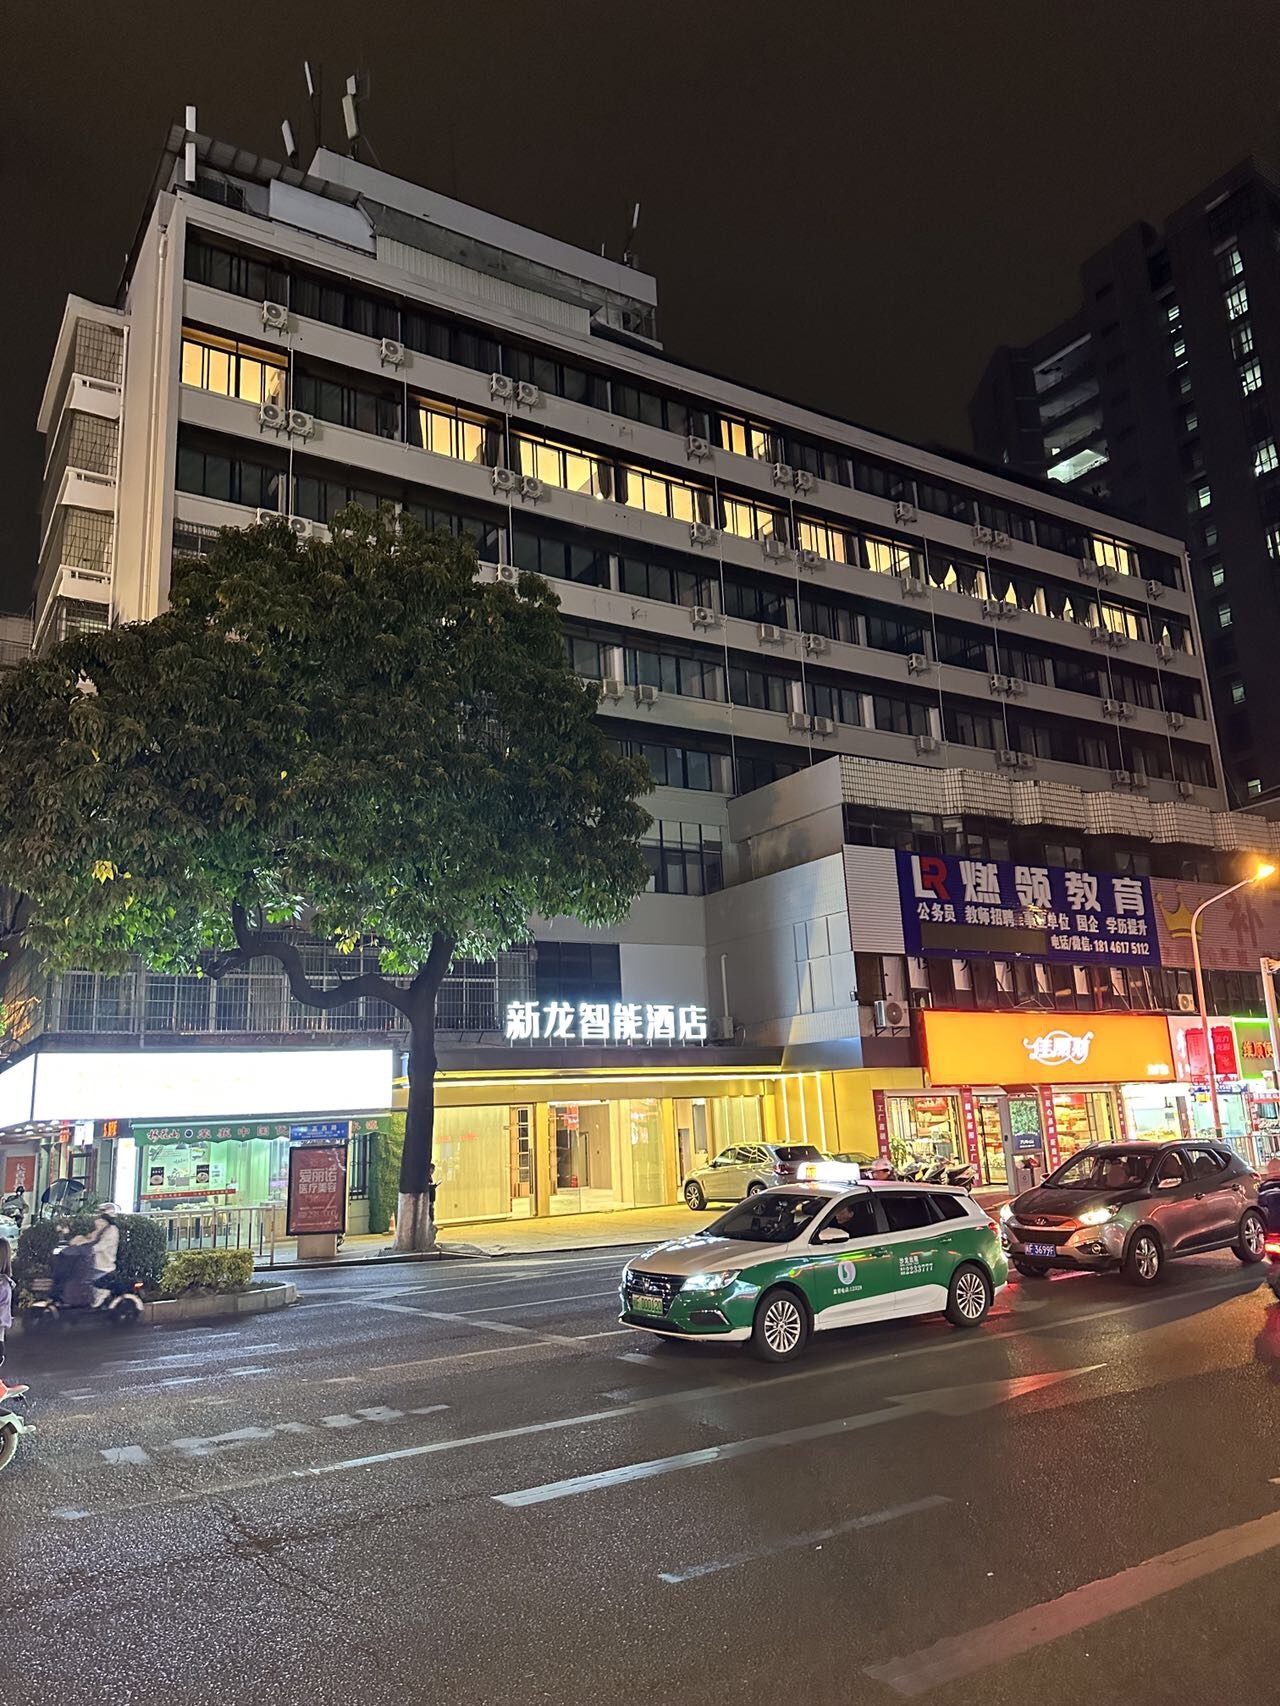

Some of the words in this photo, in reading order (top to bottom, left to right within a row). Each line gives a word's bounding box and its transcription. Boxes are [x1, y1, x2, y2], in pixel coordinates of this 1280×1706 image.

[959, 860, 1145, 916] 燃领教育
[917, 902, 956, 922] 公务员
[965, 905, 1015, 927] 教师招聘
[1076, 914, 1099, 933] 国企
[1106, 917, 1147, 936] 学历提升
[1050, 934, 1093, 952] 电话/微信:
[1094, 940, 1109, 953] 181
[1110, 941, 1129, 954] 4617
[1131, 943, 1150, 955] 5112
[505, 1001, 708, 1040] 新龙智能酒店
[300, 1165, 337, 1183] 爱丽诺
[299, 1183, 337, 1194] 医疗美容
